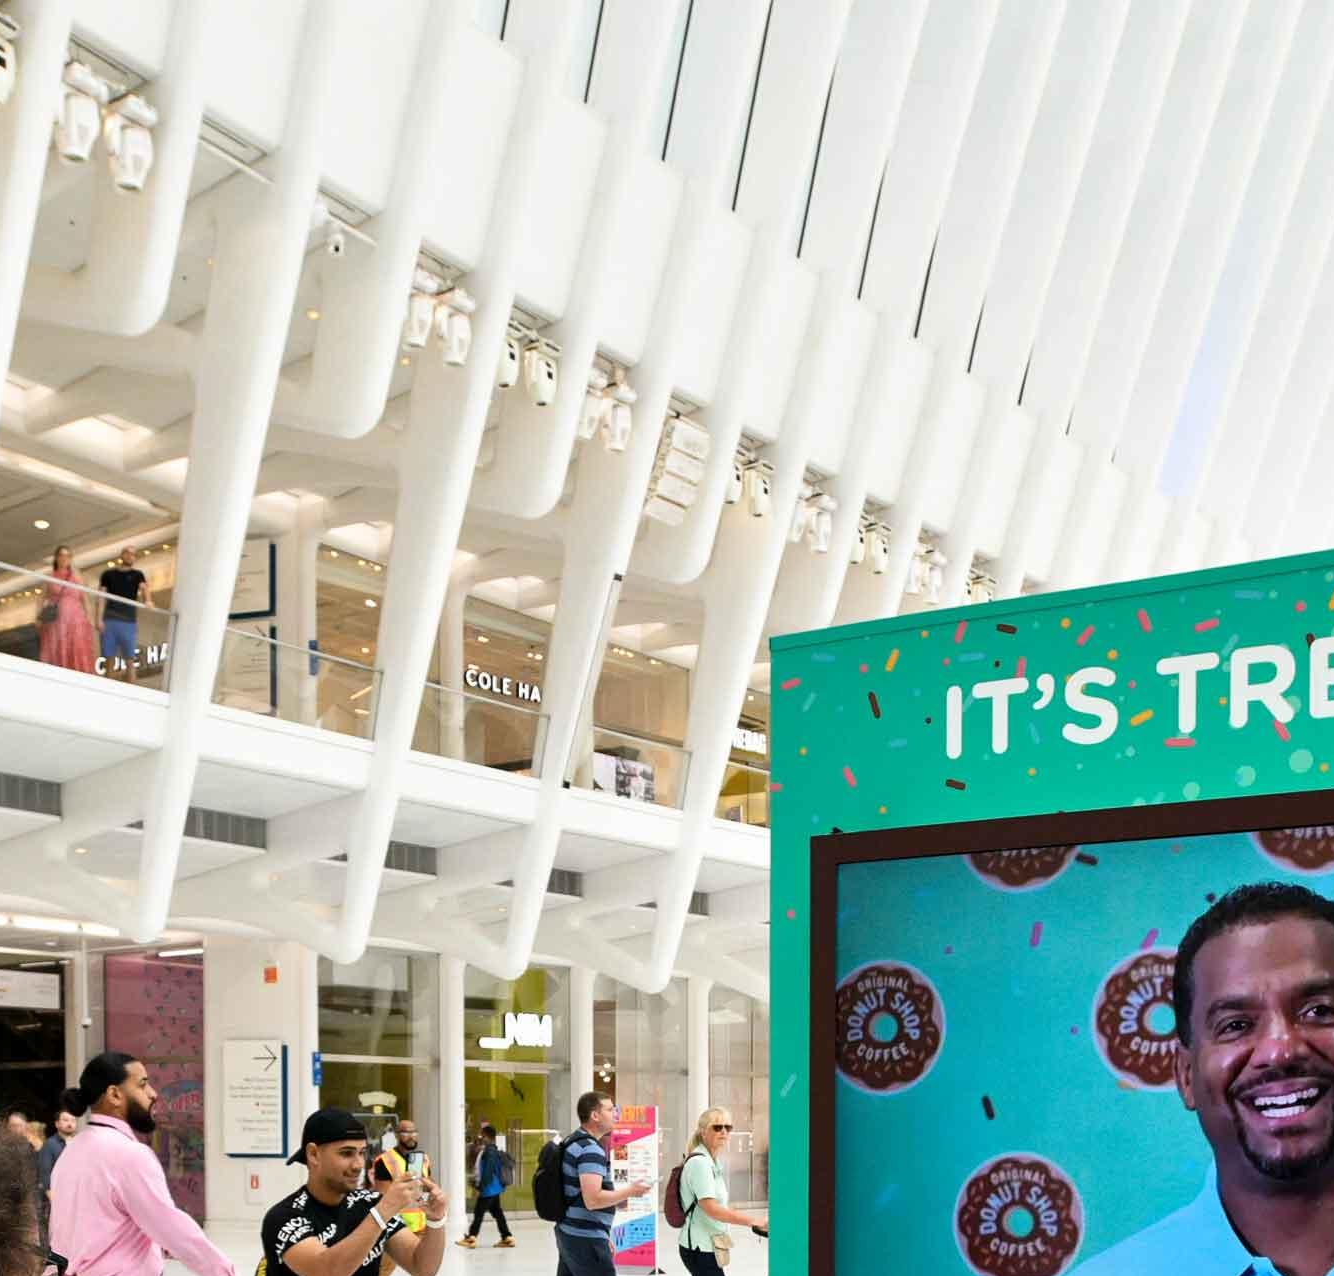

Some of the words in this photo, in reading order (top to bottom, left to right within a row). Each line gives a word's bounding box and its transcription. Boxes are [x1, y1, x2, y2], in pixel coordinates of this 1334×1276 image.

[465, 669, 512, 695] COLE
[856, 974, 909, 993] ORIGINAL
[847, 989, 886, 1042] DONUT
[889, 991, 921, 1041] SHOP
[1119, 976, 1164, 1035] DONUT
[856, 1041, 910, 1062] COFFEE
[990, 1168, 1047, 1186] ORIGINAL
[979, 1181, 1021, 1236] DONUT
[1026, 1185, 1059, 1237] SHOP
[990, 1237, 1046, 1257] COFFEE
